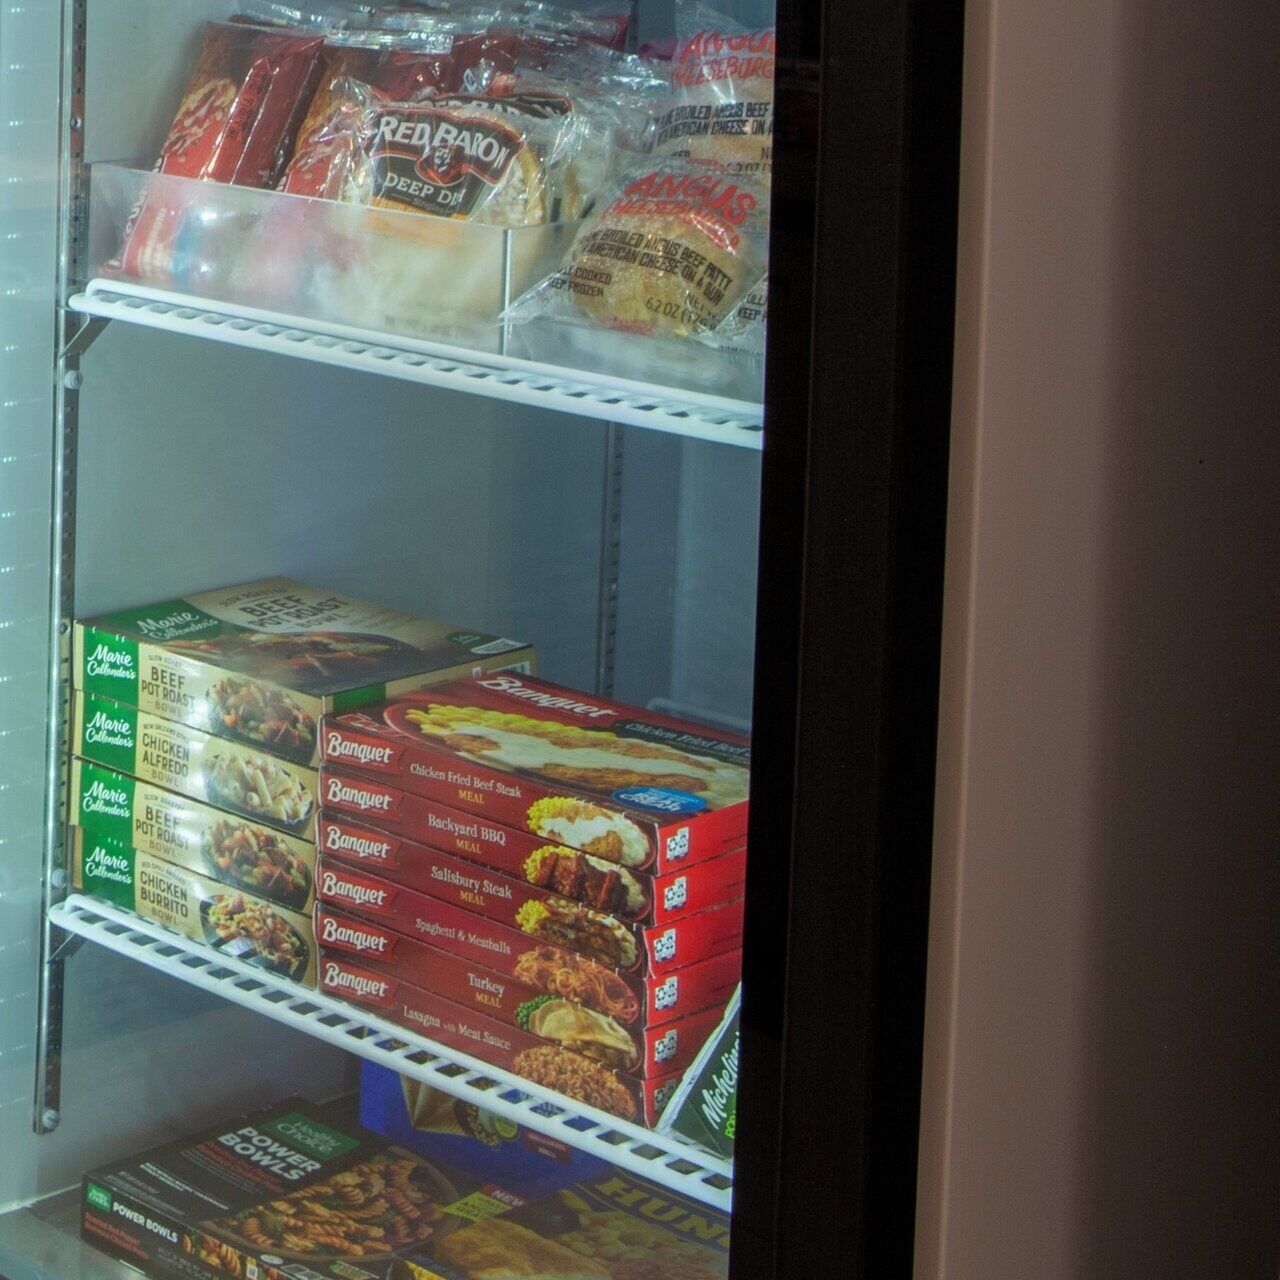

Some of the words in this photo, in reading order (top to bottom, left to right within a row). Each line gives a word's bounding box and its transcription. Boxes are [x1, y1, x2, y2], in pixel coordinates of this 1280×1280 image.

[673, 104, 712, 121] BROILED
[712, 102, 744, 119] ANGUS
[745, 101, 771, 118] BEEF
[710, 119, 748, 136] CHEESE
[375, 116, 430, 147] RED
[431, 121, 510, 169] BARON
[384, 173, 435, 198] DEEP
[623, 170, 757, 225] ANGUS
[600, 227, 645, 249] BROILED
[643, 234, 682, 258] ANGUS
[681, 244, 708, 268] BEEF
[703, 258, 734, 291] PATTY
[567, 279, 605, 297] FROZEN
[574, 266, 612, 286] COOKED
[639, 252, 682, 276] CHEESE
[681, 264, 697, 282] ON
[695, 276, 704, 289] A
[703, 284, 725, 307] BUN
[645, 297, 661, 311] 6.2
[663, 302, 680, 319] OZ
[238, 594, 304, 619] BEEF
[245, 613, 288, 630] POT
[286, 596, 350, 623] ROAST
[136, 611, 200, 635] Marie
[148, 619, 218, 641] Callender's
[86, 643, 134, 667] Marie
[86, 660, 137, 680] Callender's
[151, 666, 186, 690] BEEF
[141, 680, 161, 698] POT
[162, 686, 196, 708] ROAST
[476, 675, 620, 719] Banquet
[85, 710, 132, 735] Marie
[624, 722, 678, 741] Chicken
[679, 733, 713, 749] Fried
[85, 727, 134, 748] Callender's
[142, 732, 190, 762] CHICKEN
[326, 732, 394, 764] Banquet
[142, 750, 189, 778] ALFREDO
[151, 767, 181, 788] BOWL
[82, 779, 129, 805] Marie
[327, 778, 393, 810] Banquet
[410, 763, 446, 781] Chicken
[447, 771, 471, 787] Fried
[473, 777, 495, 791] Beef
[496, 781, 523, 799] Steak
[82, 797, 131, 818] Callender's
[458, 789, 485, 805] MEAL
[145, 805, 180, 830] BEEF
[428, 813, 479, 839] Backyard
[480, 826, 506, 846] BBQ
[135, 818, 155, 838] POT
[157, 829, 189, 851] ROAST
[149, 839, 179, 856] BOWL
[326, 825, 391, 858] Banquet
[456, 838, 482, 854] MEAL
[85, 846, 130, 871] Marie
[85, 862, 133, 885] Callender's
[140, 871, 188, 902] CHICKEN
[430, 865, 480, 893] Salisbury
[482, 880, 513, 900] Steak
[322, 871, 388, 906] Banquet
[459, 890, 486, 906] MEAL
[141, 887, 189, 918] BURRITO
[151, 907, 179, 926] BOWL
[322, 917, 388, 952] Banquet
[415, 918, 456, 940] Spaghetti
[457, 930, 466, 941] &
[467, 932, 512, 955] Meatballs
[323, 962, 389, 997] Banquet
[467, 972, 505, 997] Turkey
[474, 992, 502, 1009] MEAL
[403, 1005, 441, 1028] Lasagna
[457, 1023, 481, 1042] Meat
[482, 1031, 512, 1050] Sauce
[276, 1122, 333, 1154] Choice
[292, 1121, 341, 1148] Healthy
[218, 1132, 306, 1181] BOWLS
[237, 1126, 322, 1172] POWER
[490, 1189, 525, 1208] NEW
[113, 1201, 146, 1227] POWER
[145, 1219, 179, 1244] BOWLS
[594, 1176, 729, 1249] HUN
